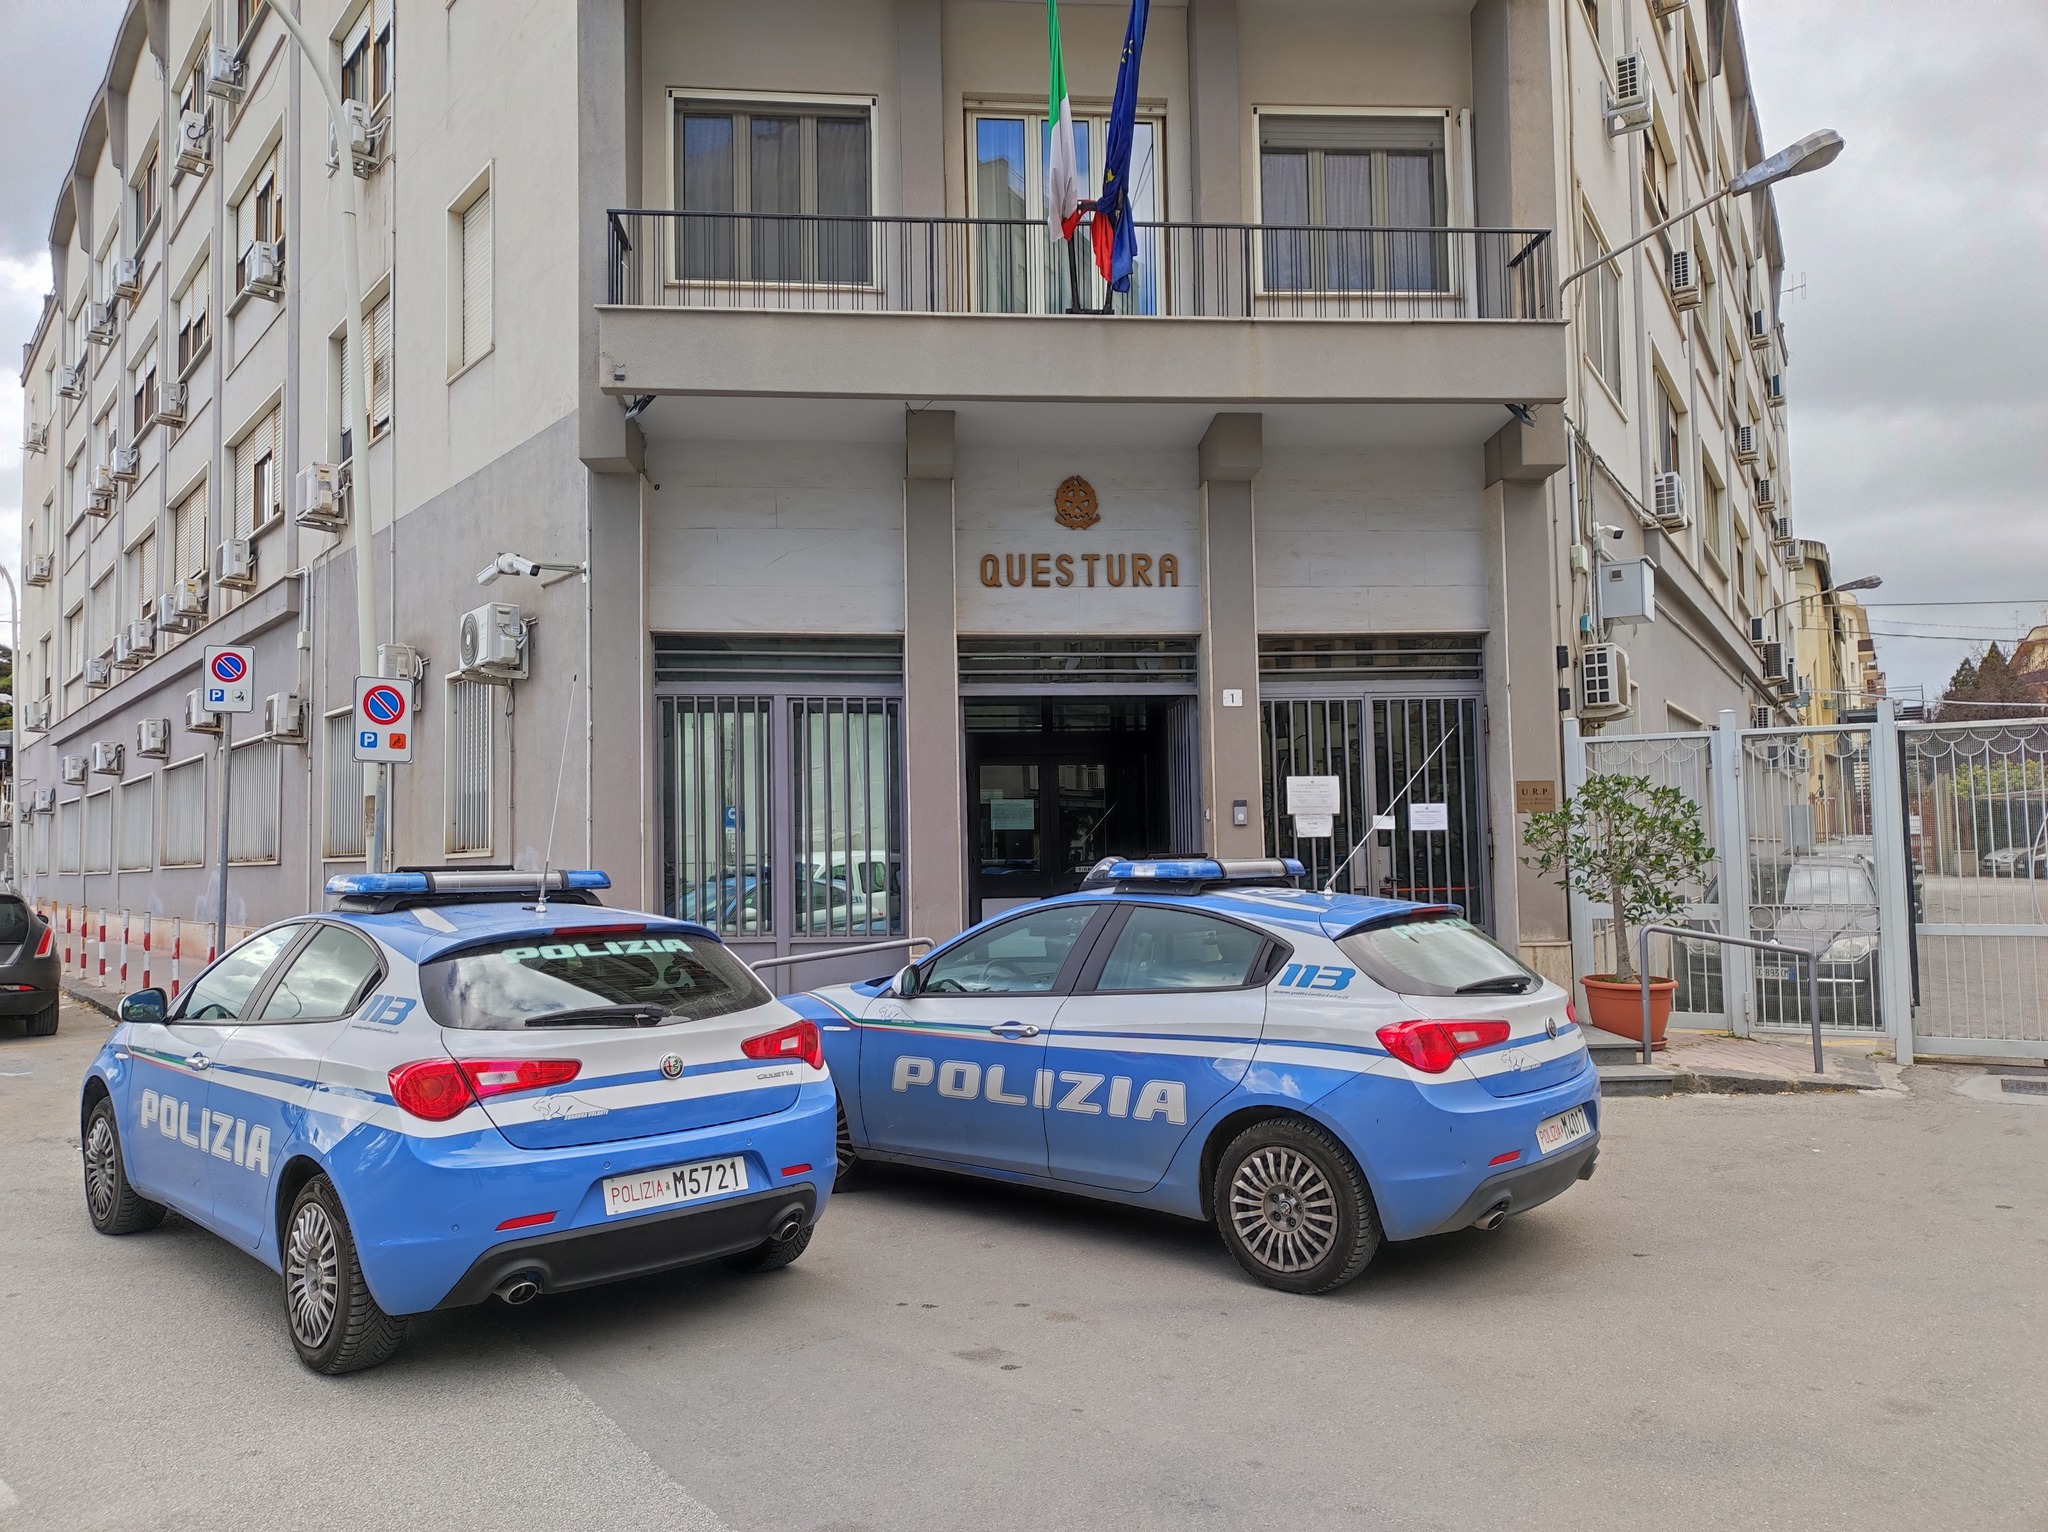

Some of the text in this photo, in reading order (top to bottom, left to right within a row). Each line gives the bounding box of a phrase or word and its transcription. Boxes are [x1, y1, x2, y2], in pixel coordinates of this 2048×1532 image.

[979, 553, 1179, 587] QUESTURA
[211, 690, 222, 701] P
[1230, 693, 1235, 704] 1
[363, 733, 375, 747] P
[1390, 918, 1473, 940] POLIZIA
[501, 939, 694, 965] POLIZIA
[1278, 963, 1357, 991] 113
[358, 993, 417, 1026] 113
[891, 1055, 1188, 1126] POLIZIA
[141, 1088, 272, 1178] POLIZIA
[1538, 1108, 1588, 1146] POLIZIA M4017
[611, 1161, 739, 1206] POLIZIA M5721
